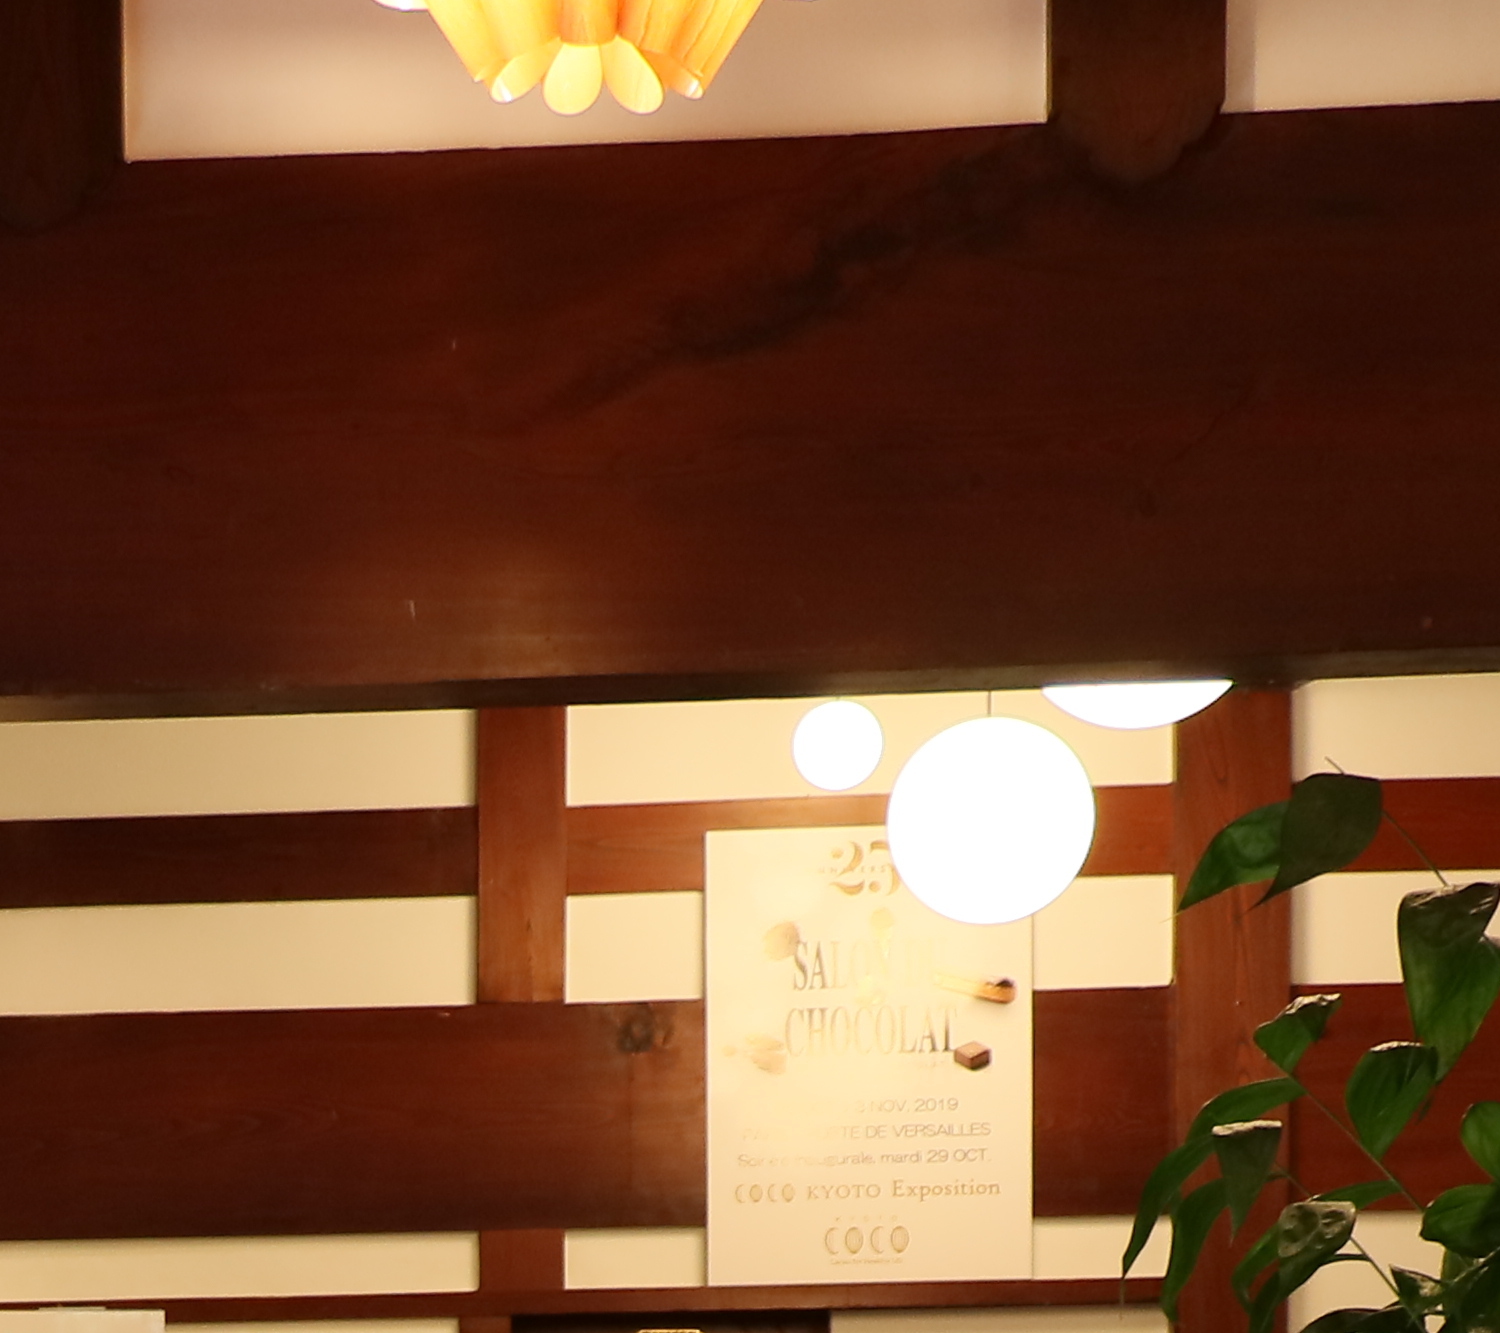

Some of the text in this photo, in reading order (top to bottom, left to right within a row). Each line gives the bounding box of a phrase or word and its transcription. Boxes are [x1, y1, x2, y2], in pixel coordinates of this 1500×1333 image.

[785, 1003, 959, 1058] CHOCOLAT
[915, 1098, 959, 1112] 2019
[865, 1124, 888, 1139] DE
[893, 1121, 992, 1138] VERSAILLES
[881, 1150, 923, 1164] mardi
[926, 1150, 949, 1164] 29
[734, 1178, 1002, 1204] COCO KYOTO Exposition
[824, 1224, 910, 1256] COCO
